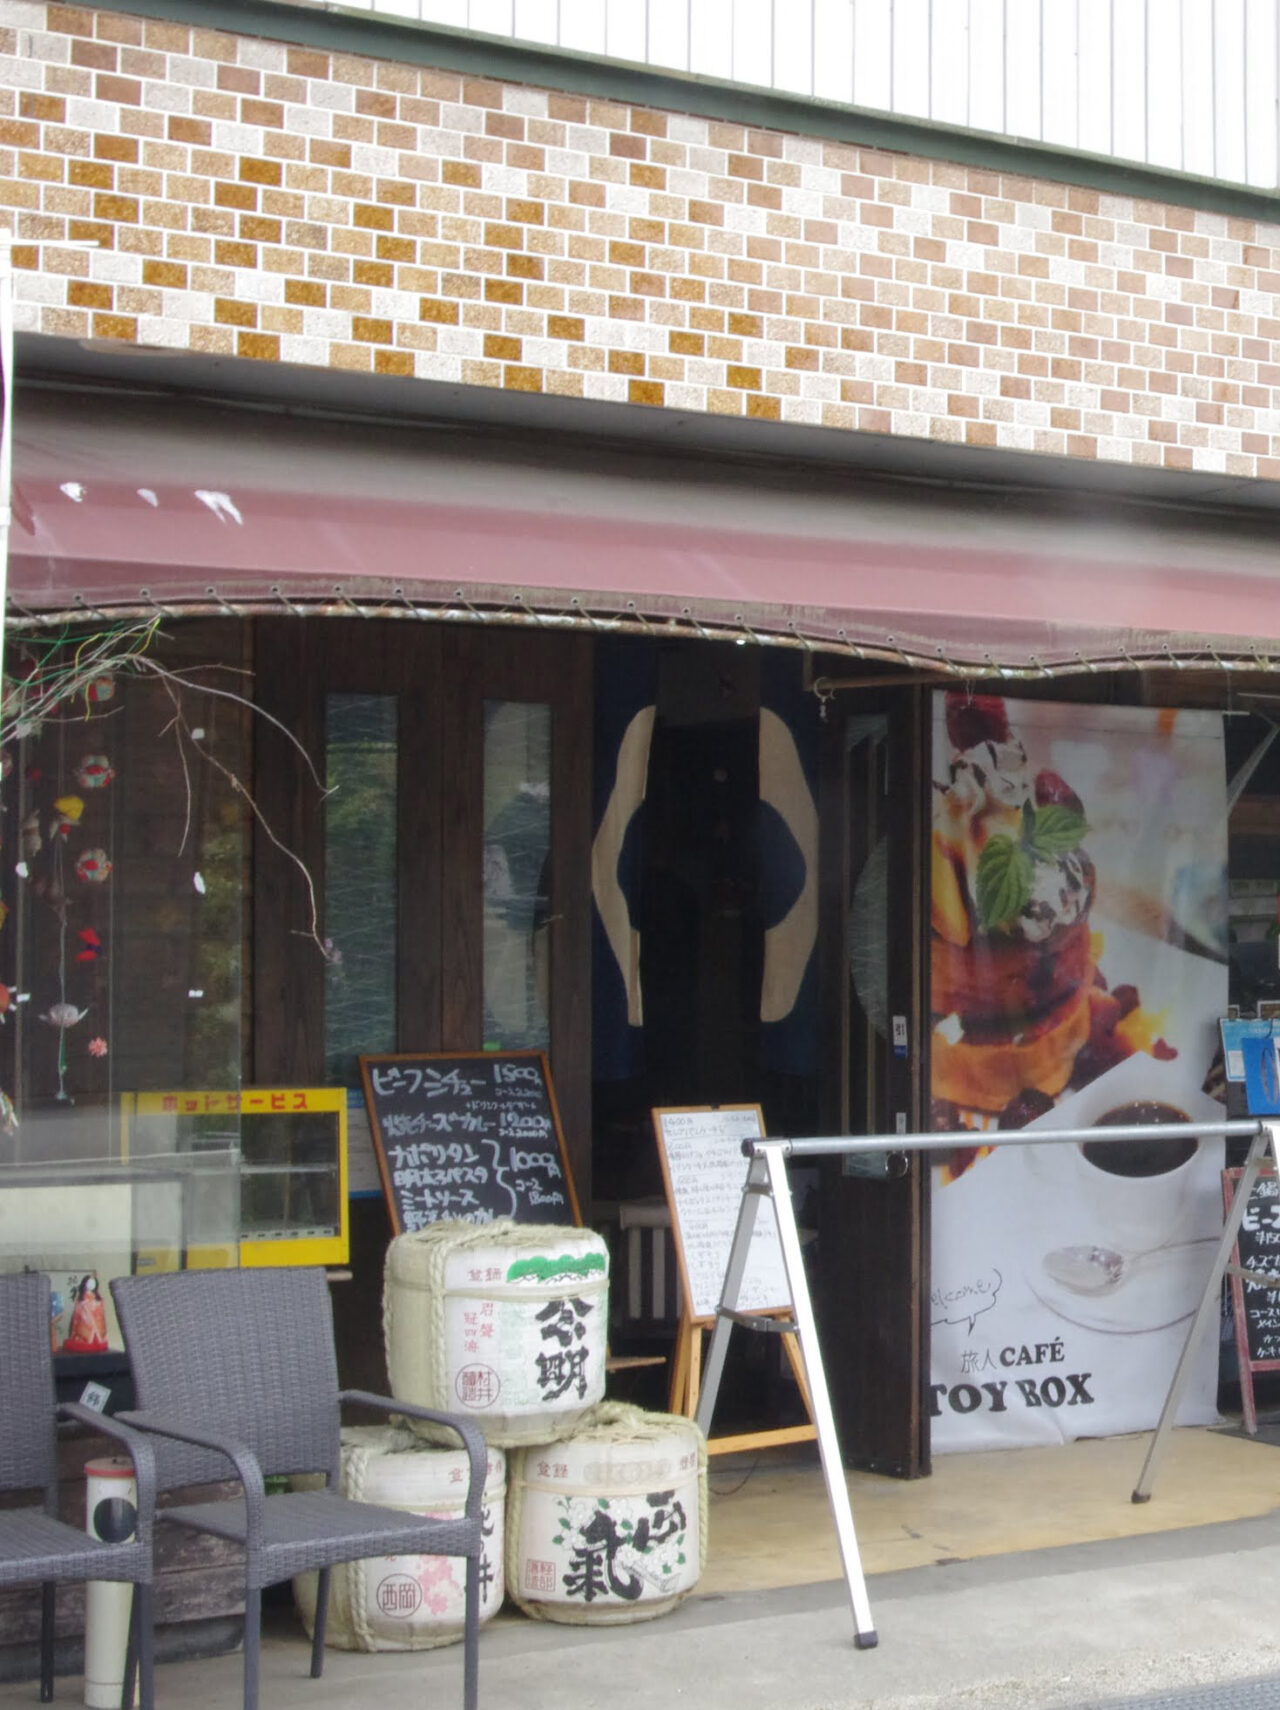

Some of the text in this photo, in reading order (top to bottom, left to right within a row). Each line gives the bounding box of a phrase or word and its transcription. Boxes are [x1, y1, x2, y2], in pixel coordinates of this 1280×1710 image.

[162, 1093, 307, 1113] ホットサービス
[961, 1336, 1066, 1374] 旅人 CAFÉ
[929, 1372, 1095, 1417] TOY BOX
